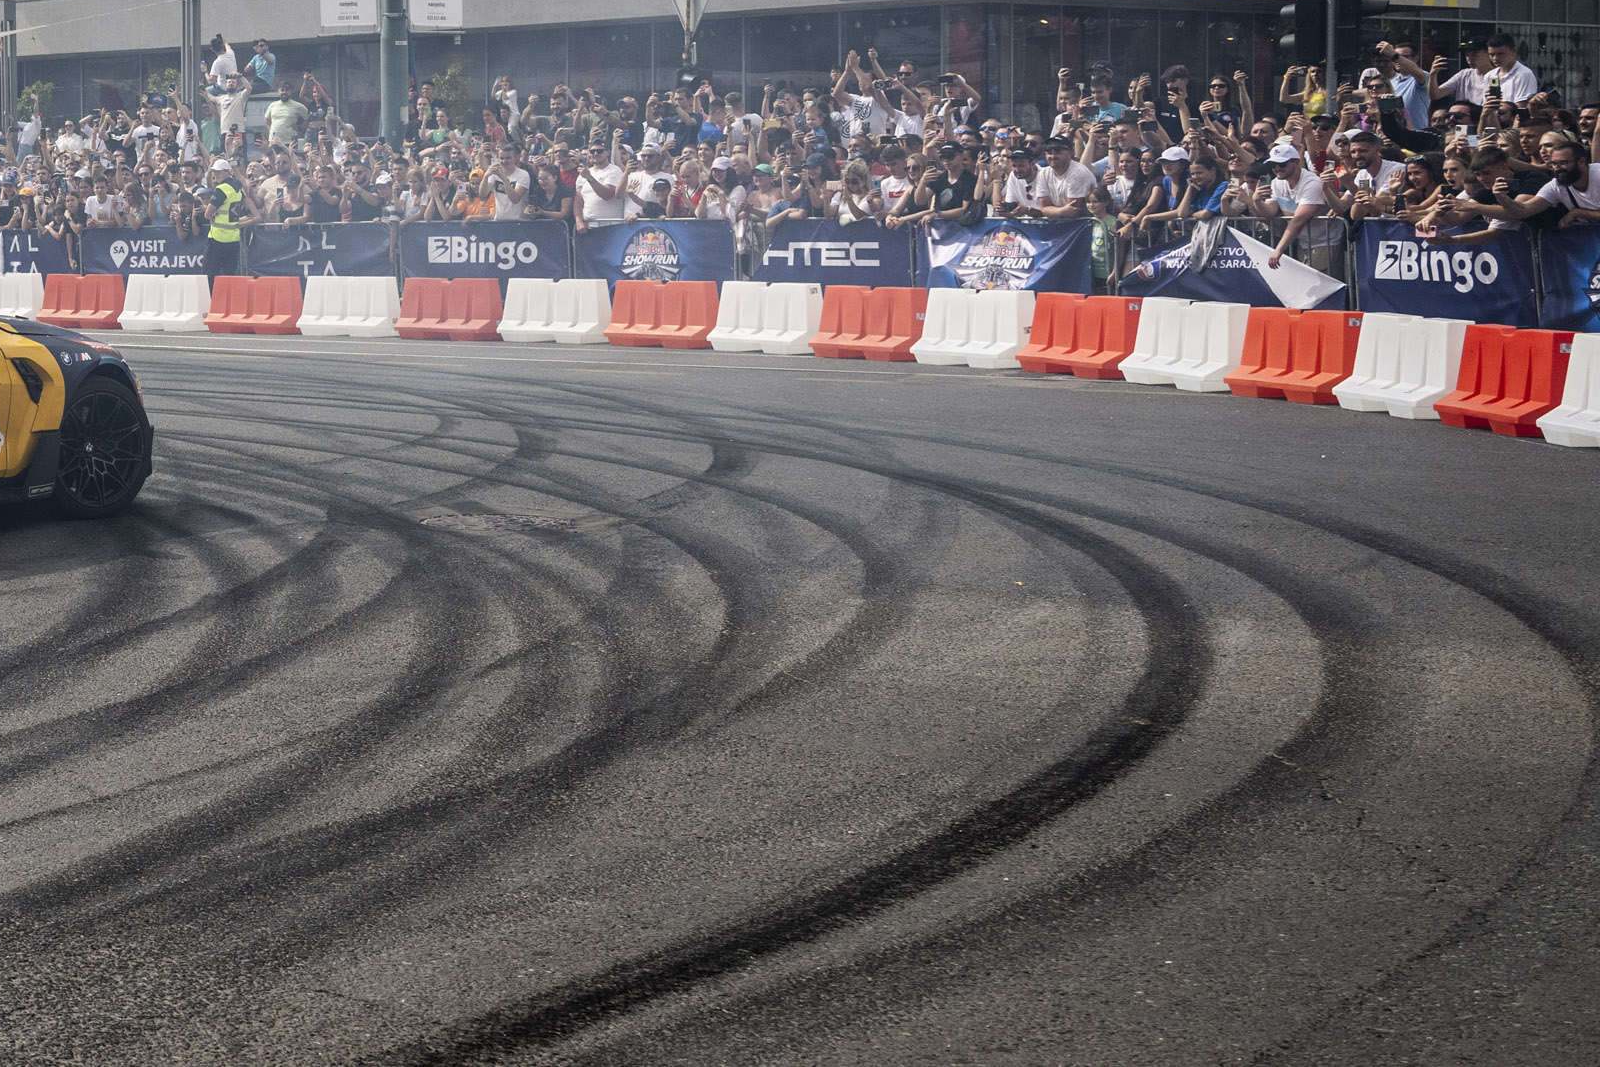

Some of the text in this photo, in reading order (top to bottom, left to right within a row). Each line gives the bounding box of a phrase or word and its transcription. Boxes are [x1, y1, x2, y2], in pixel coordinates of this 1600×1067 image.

[130, 240, 166, 253] VISIT
[451, 234, 538, 270] Bingo
[762, 241, 880, 267] HTEC
[622, 254, 679, 266] SHOWRUN
[961, 255, 1034, 269] SHOWRUN
[1401, 238, 1499, 294] Bingo
